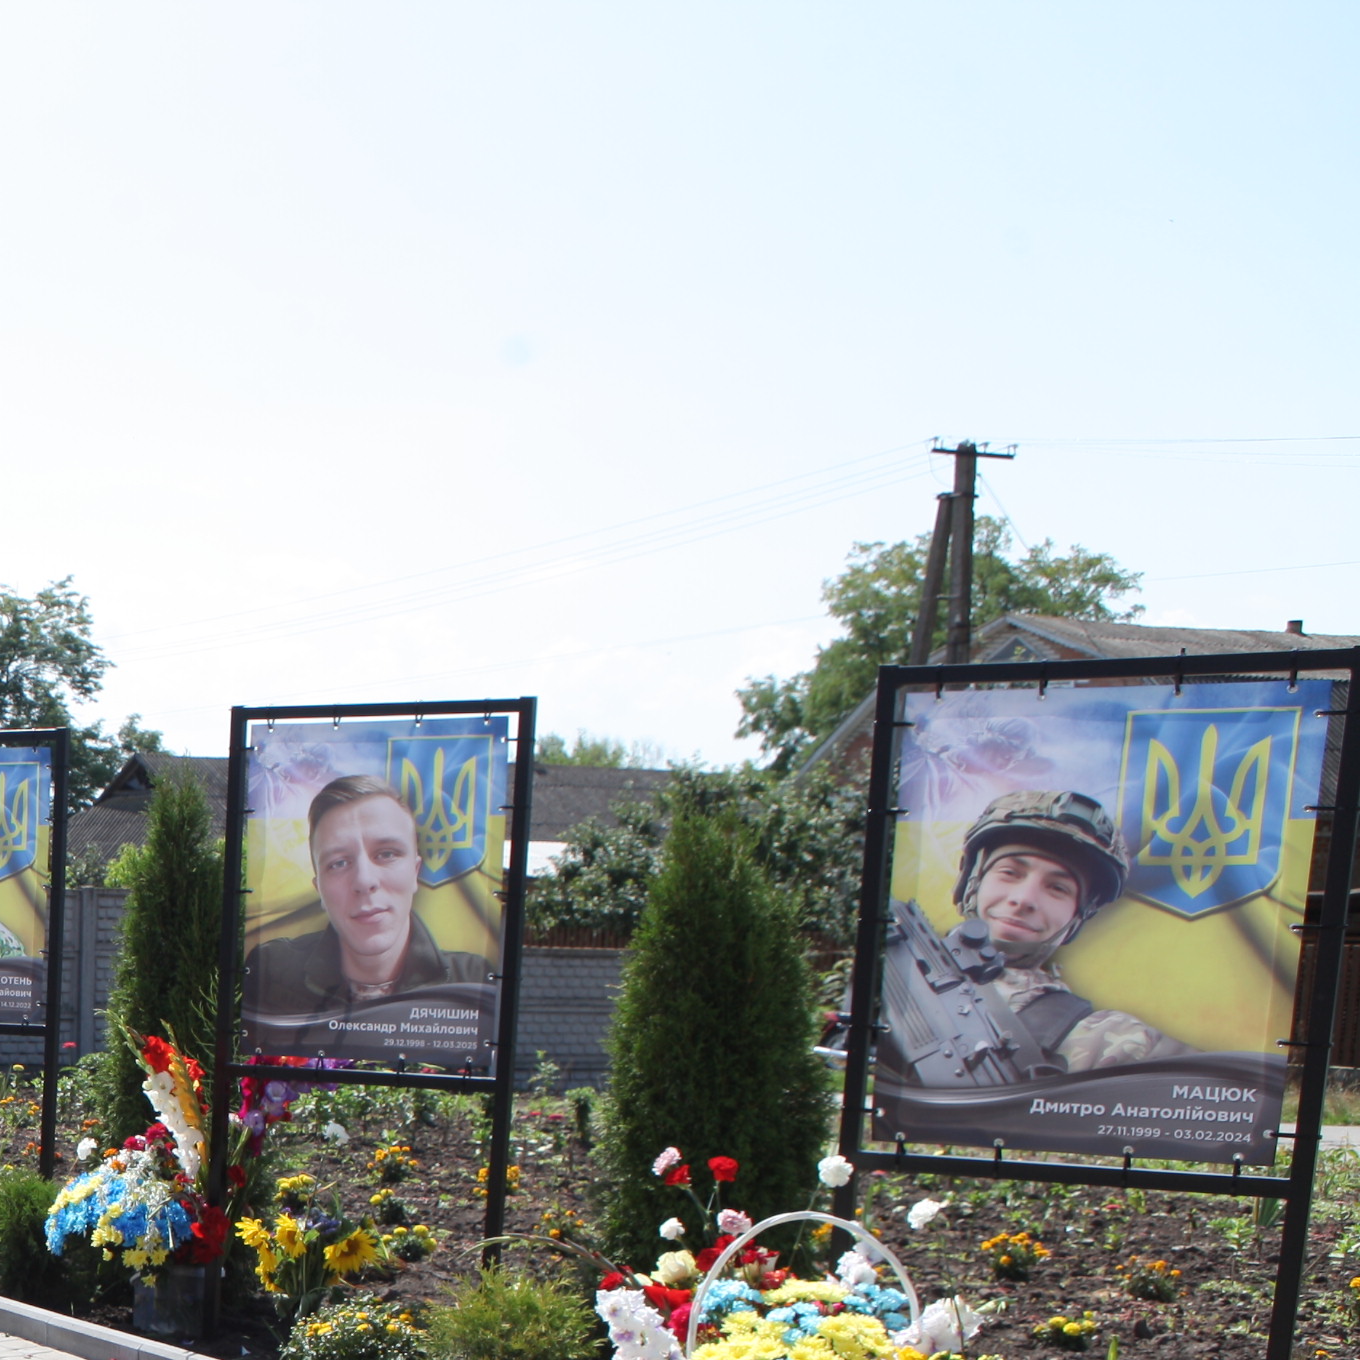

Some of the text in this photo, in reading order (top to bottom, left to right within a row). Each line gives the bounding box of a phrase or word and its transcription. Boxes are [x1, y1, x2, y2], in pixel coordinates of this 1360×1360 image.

[409, 1007, 479, 1020] ДЯЧИШИН
[328, 1020, 479, 1036] Олександр Михайлович
[383, 1038, 425, 1047] 29.12.1998
[433, 1039, 478, 1049] 12.03.2025
[1172, 1085, 1257, 1103] МАЦЮК
[1030, 1098, 1254, 1124] Дмитро Анатолійович
[1097, 1125, 1161, 1138] 27.11.1999
[1174, 1129, 1252, 1143] 03.02.2024
